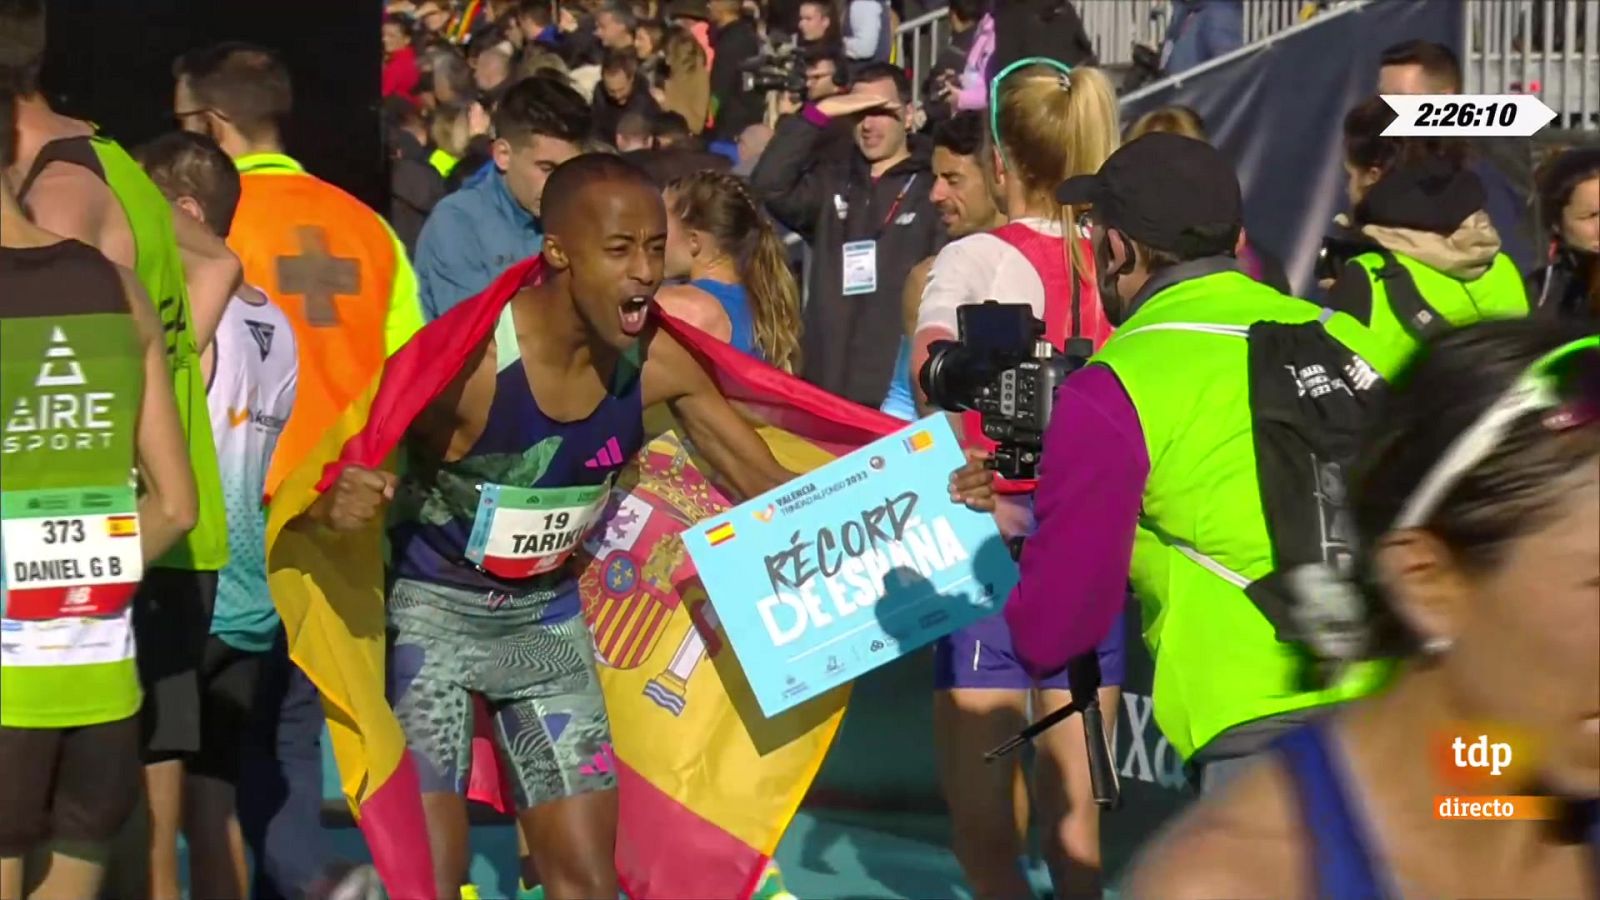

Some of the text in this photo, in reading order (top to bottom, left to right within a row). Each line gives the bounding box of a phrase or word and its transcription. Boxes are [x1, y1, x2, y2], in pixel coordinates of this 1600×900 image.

[5, 392, 115, 433] AIRE
[1, 432, 115, 454] SPORT
[775, 482, 817, 507] VALENCIA
[42, 519, 86, 544] 373
[543, 511, 570, 530] 19
[764, 490, 919, 602] RÉCORD
[14, 556, 122, 582] DANIEL G B
[756, 515, 969, 647] DE ESPAÑA
